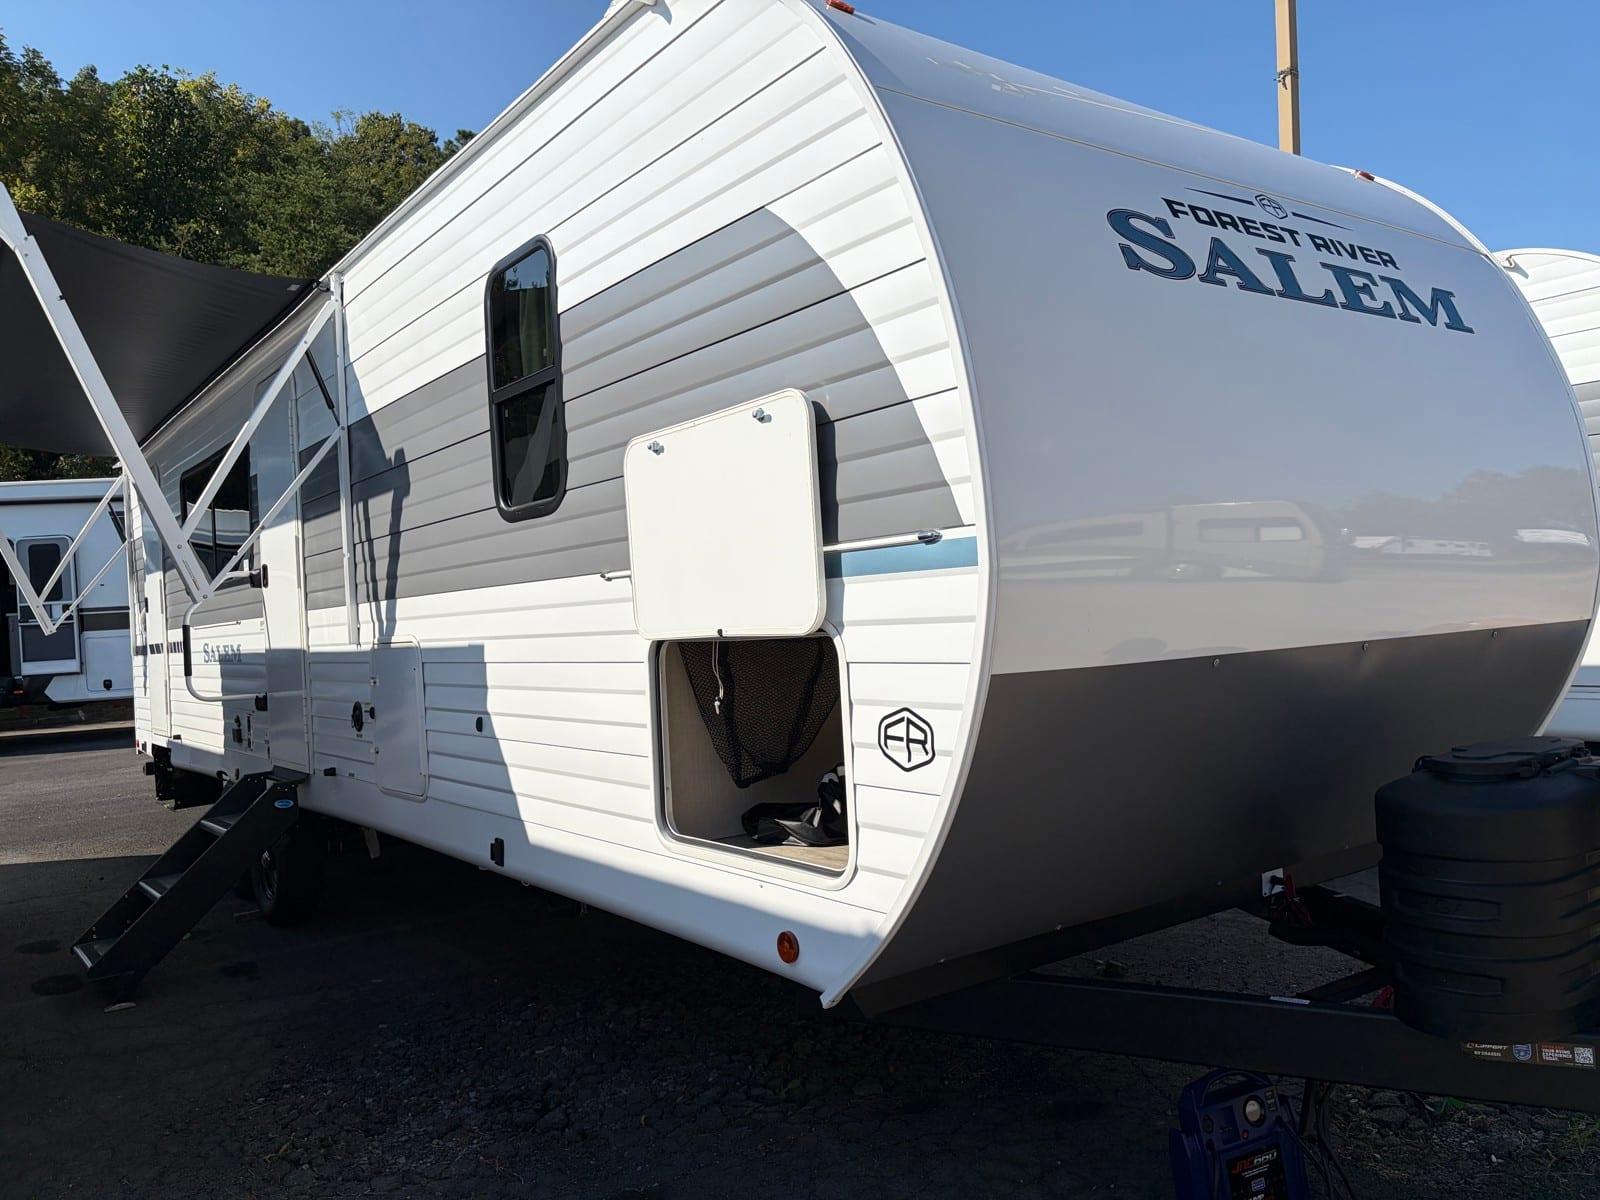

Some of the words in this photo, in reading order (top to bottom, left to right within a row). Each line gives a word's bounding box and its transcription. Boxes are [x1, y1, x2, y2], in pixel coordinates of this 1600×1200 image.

[1161, 197, 1303, 248] FOREST
[1306, 233, 1400, 271] RIVER
[1106, 208, 1475, 335] SALEM
[203, 643, 242, 664] SALEM
